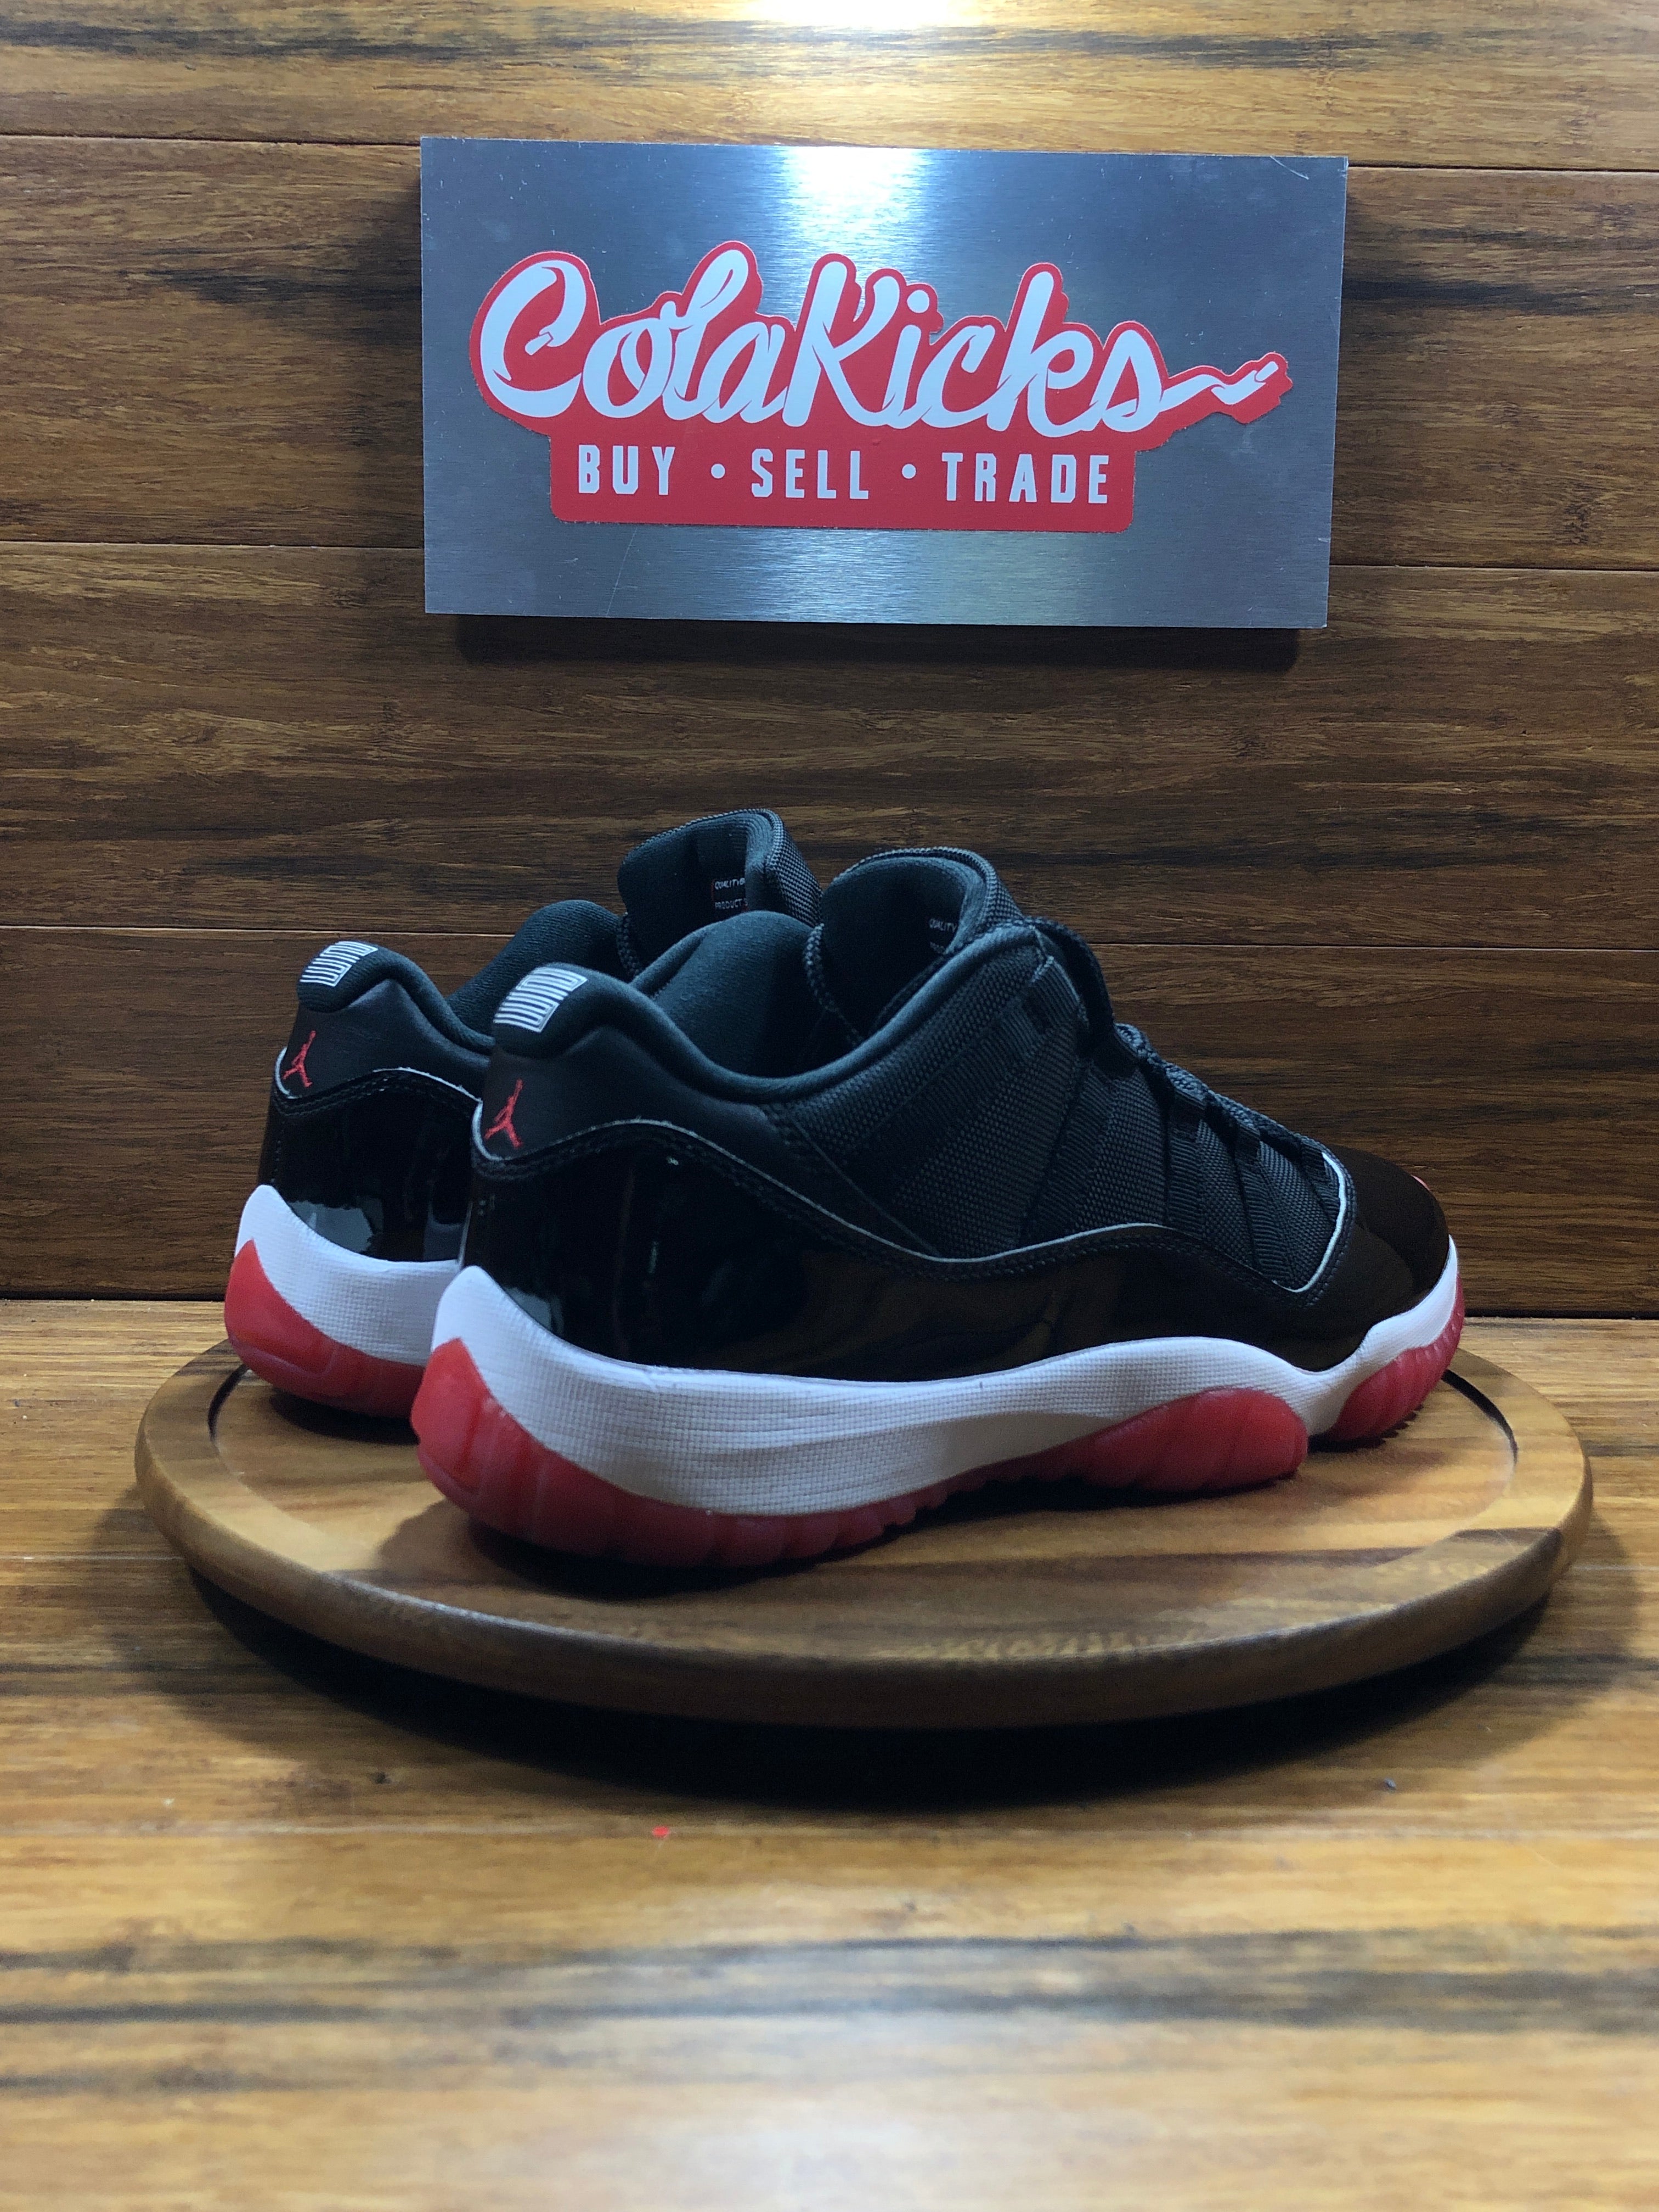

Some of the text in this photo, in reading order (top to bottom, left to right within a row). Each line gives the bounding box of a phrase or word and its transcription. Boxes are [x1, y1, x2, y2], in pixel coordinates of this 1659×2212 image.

[480, 249, 1279, 438] ColaKicks
[578, 444, 1109, 504] BUY SELL TRADE
